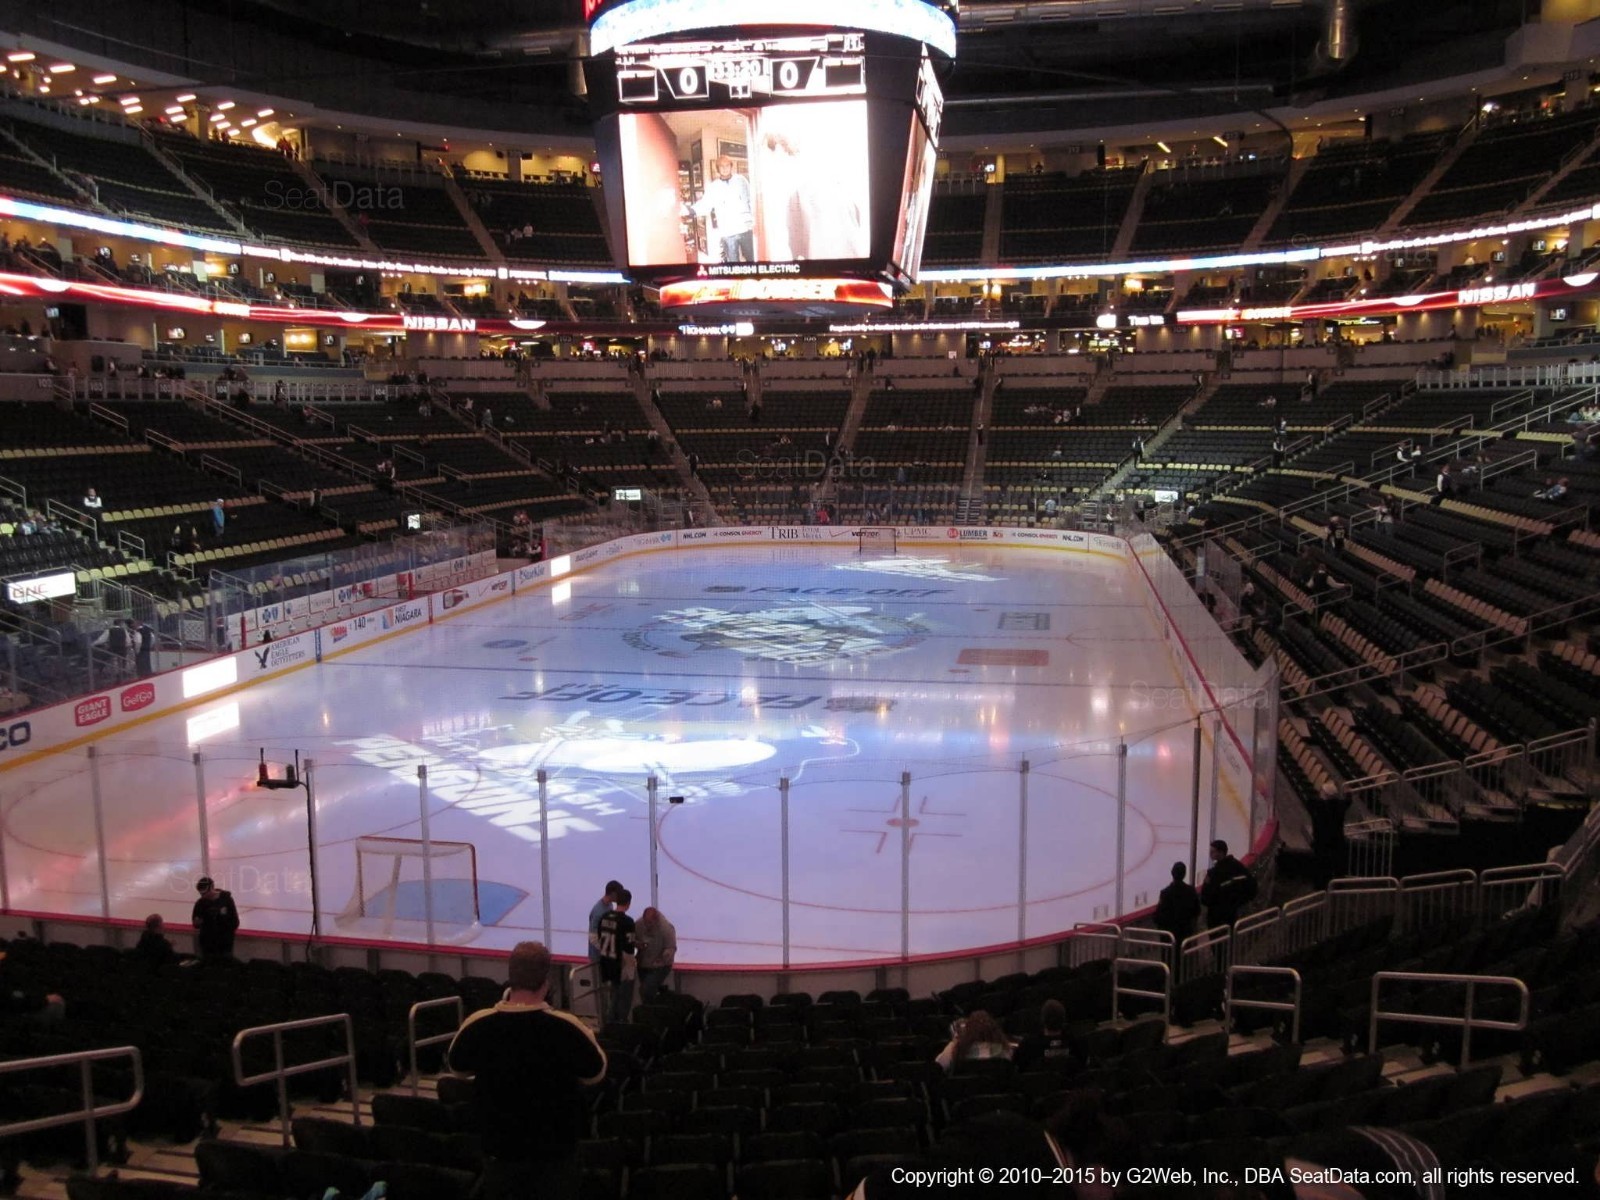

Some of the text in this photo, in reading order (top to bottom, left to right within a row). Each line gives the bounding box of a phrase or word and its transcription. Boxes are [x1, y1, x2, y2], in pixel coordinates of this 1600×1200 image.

[680, 67, 698, 95] 0
[779, 61, 799, 89] 0
[708, 264, 800, 276] MITSUBISHI ELECTRIC
[1458, 283, 1535, 304] NISSAN
[403, 316, 476, 331] NISSAN
[683, 531, 707, 541] NHL.COM
[960, 528, 988, 538] LUMBER
[395, 608, 422, 625] NIAGARA
[123, 691, 153, 707] GetGo
[78, 700, 107, 715] GIANT
[78, 708, 107, 723] EAGLE
[601, 932, 617, 959] 71
